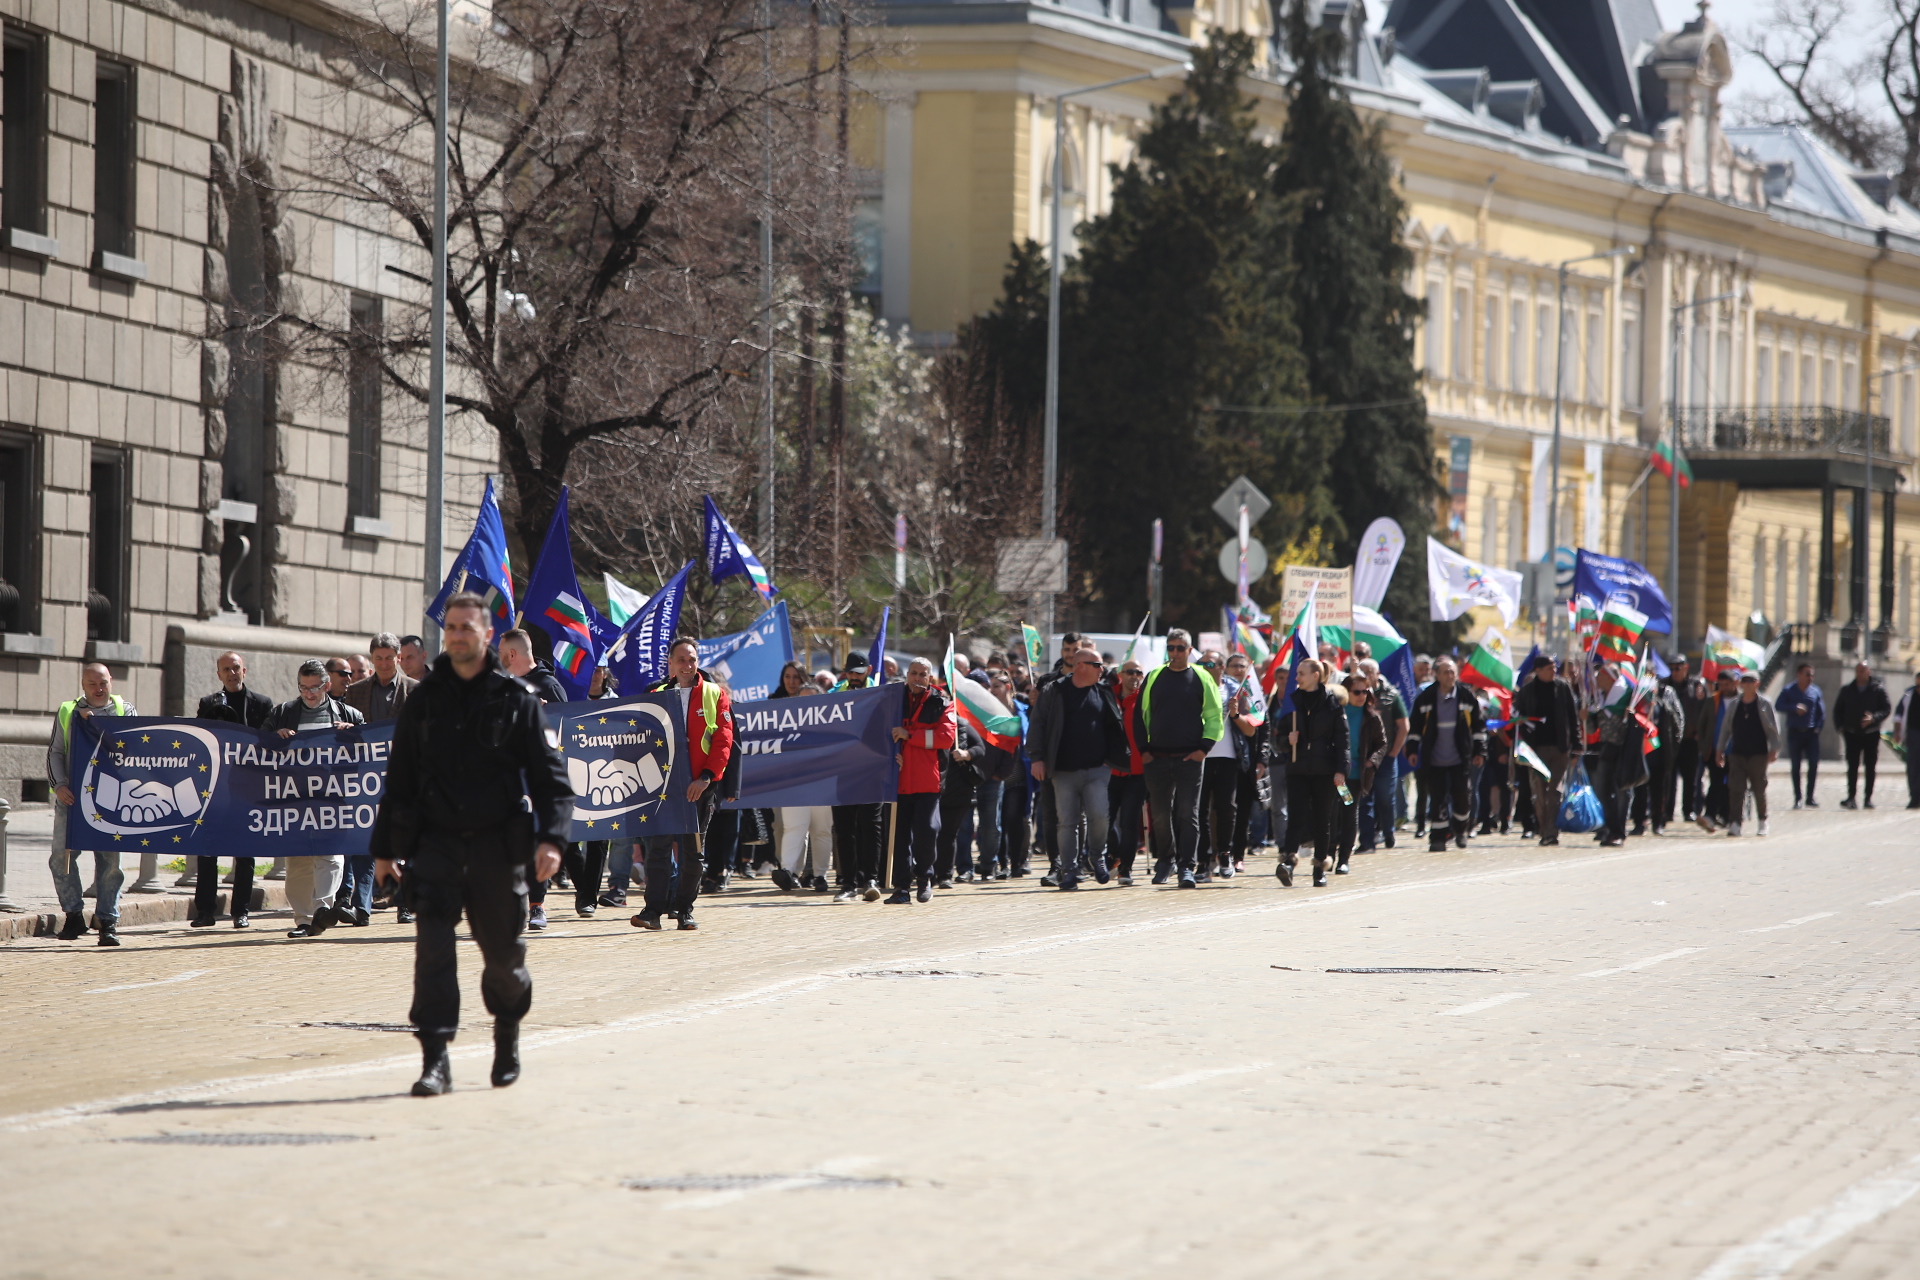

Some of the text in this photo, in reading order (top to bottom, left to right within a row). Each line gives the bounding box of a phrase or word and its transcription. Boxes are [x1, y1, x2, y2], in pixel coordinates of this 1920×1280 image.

[733, 701, 855, 733] СИНДИКАТ
[571, 729, 652, 749] "Защита"
[108, 751, 196, 771] "Защита"
[264, 775, 301, 800] НА
[248, 803, 381, 837] ЗДРАВЕО
